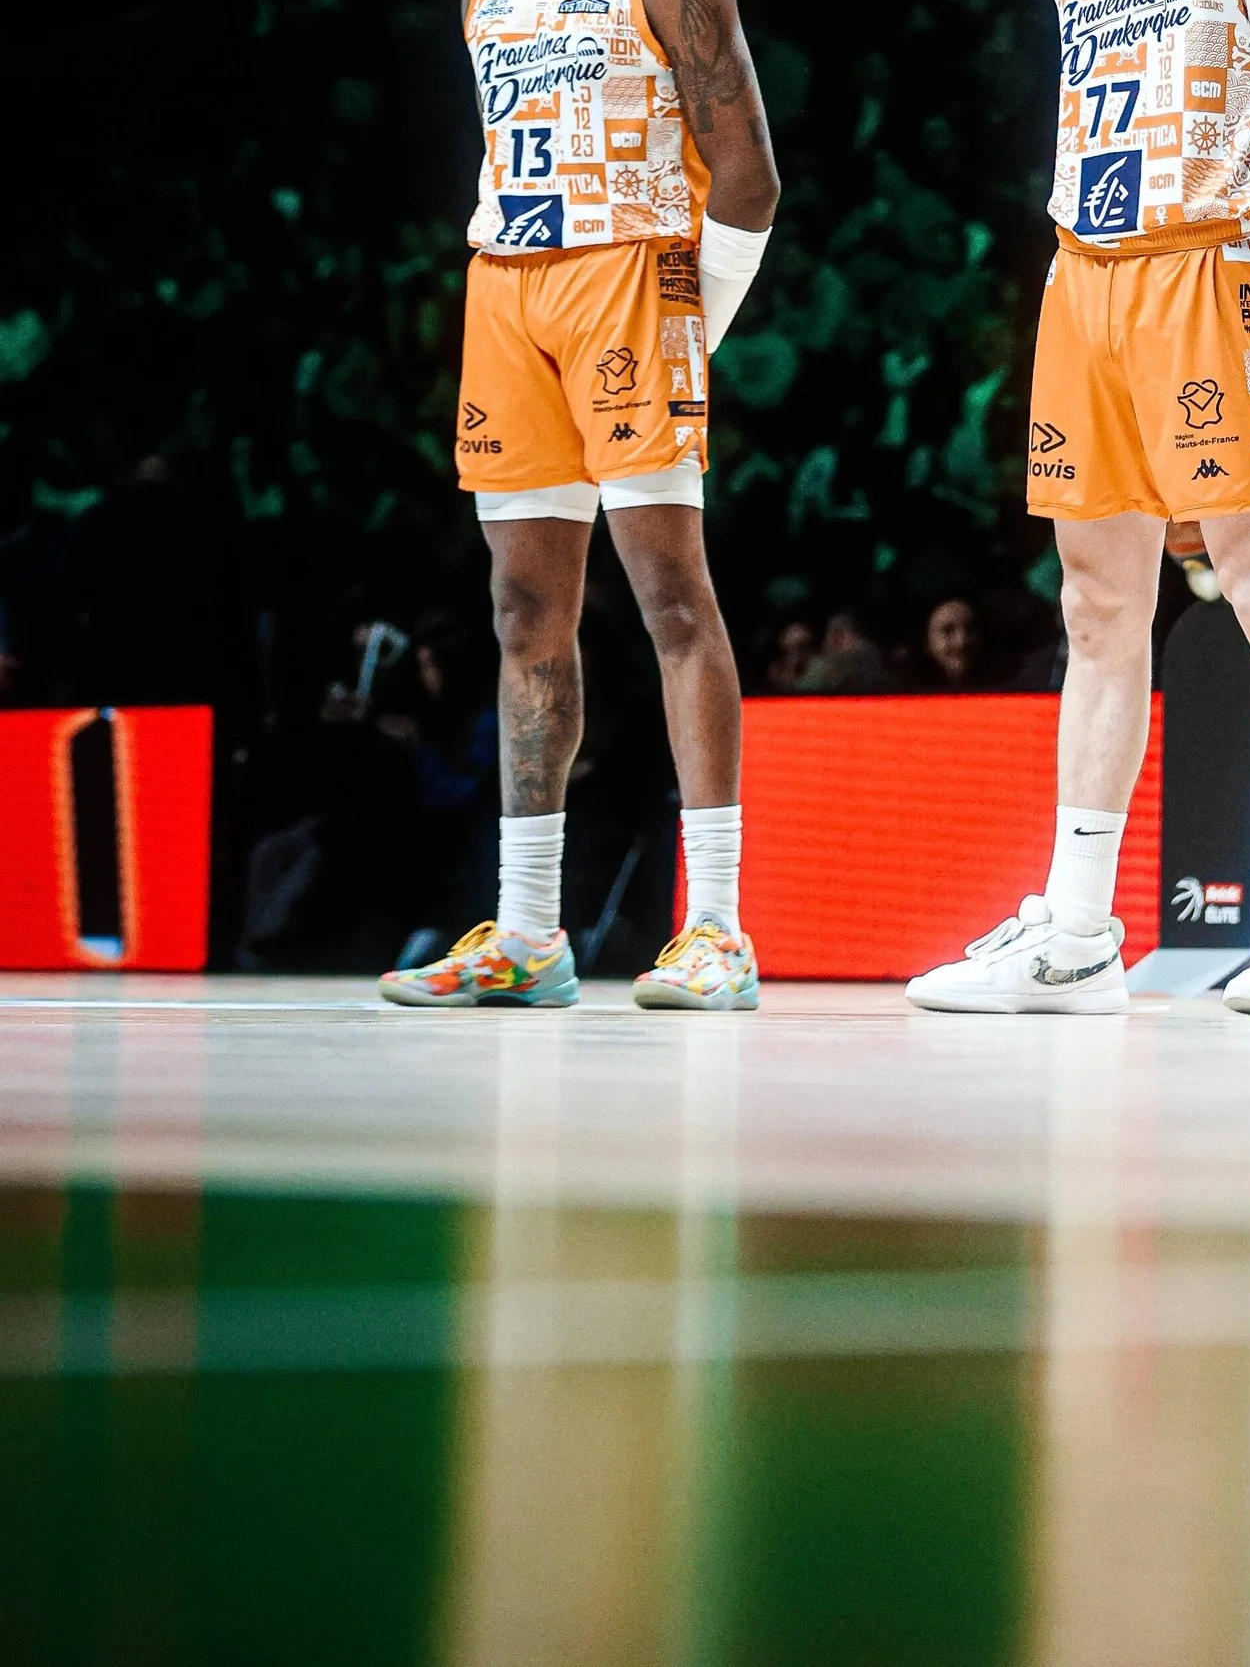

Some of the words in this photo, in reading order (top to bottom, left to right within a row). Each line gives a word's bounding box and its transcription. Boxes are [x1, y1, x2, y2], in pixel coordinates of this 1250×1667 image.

[477, 32, 572, 84] Gravelines
[1060, 6, 1192, 86] Dunkerque
[482, 61, 609, 124] Dunkerque
[1086, 79, 1141, 139] 77
[1156, 83, 1173, 109] 23
[573, 106, 592, 130] 12
[511, 128, 552, 178] 13
[571, 134, 593, 158] 23
[1175, 436, 1240, 450] Hauts-de-France
